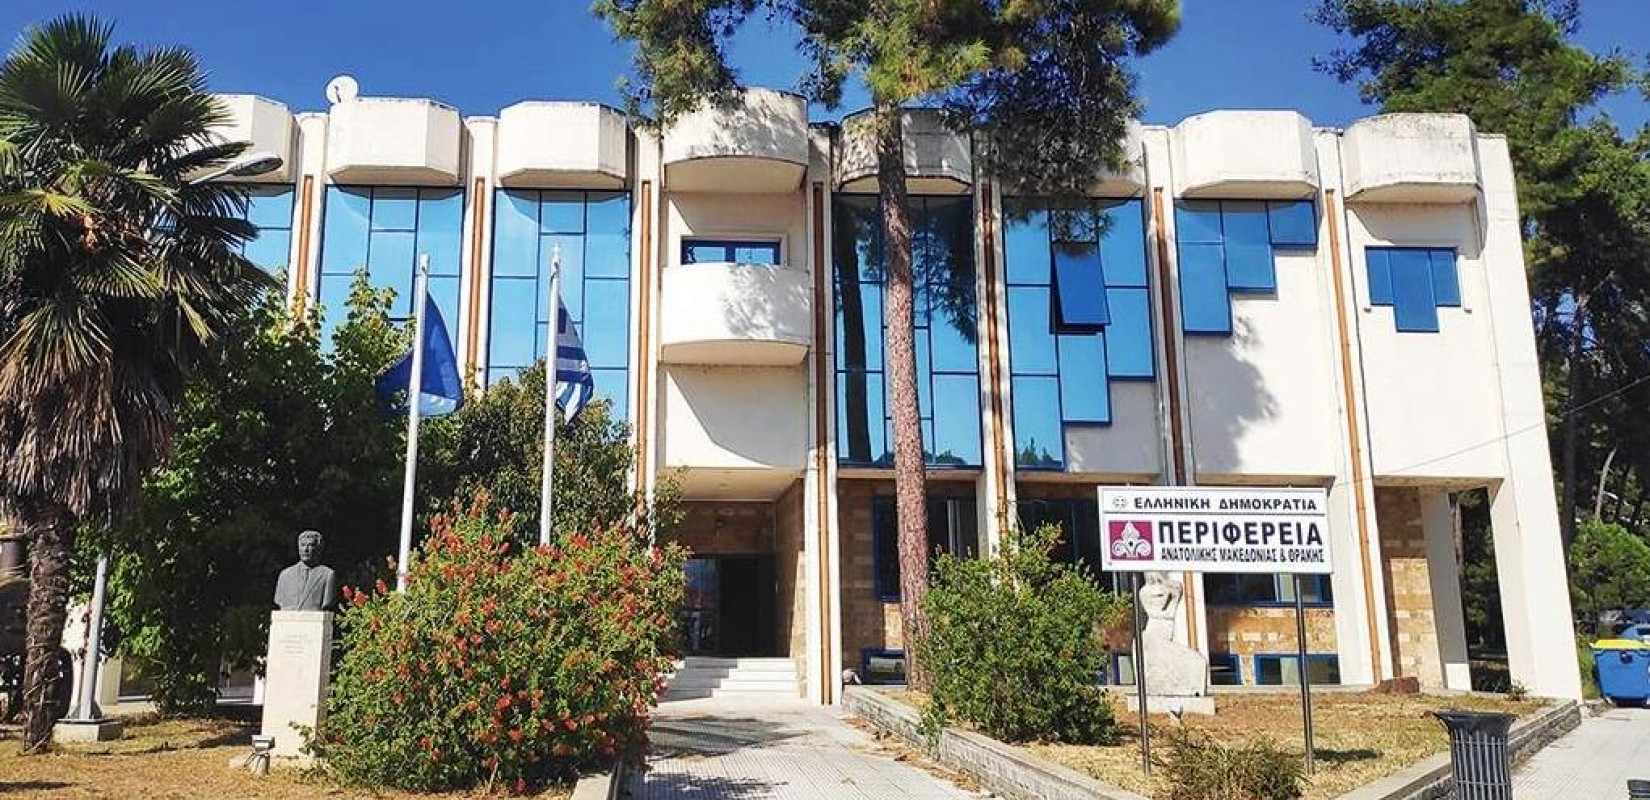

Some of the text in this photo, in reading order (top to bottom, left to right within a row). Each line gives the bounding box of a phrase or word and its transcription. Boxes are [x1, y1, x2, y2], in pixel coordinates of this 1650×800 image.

[1134, 497, 1317, 511] ΕΛΛΗΝΙΚΗ ΔΗΜΟΚΡΑΤΙΑ
[1158, 521, 1323, 546] ΠΕΡΙΦΕΡΕΙΑ
[1161, 548, 1325, 564] ΑΝΑΤΟΛΙΚΗΣ ΜΑΚΕΔΟΝΙΑΣ & ΘΡΑΚΗΣ
